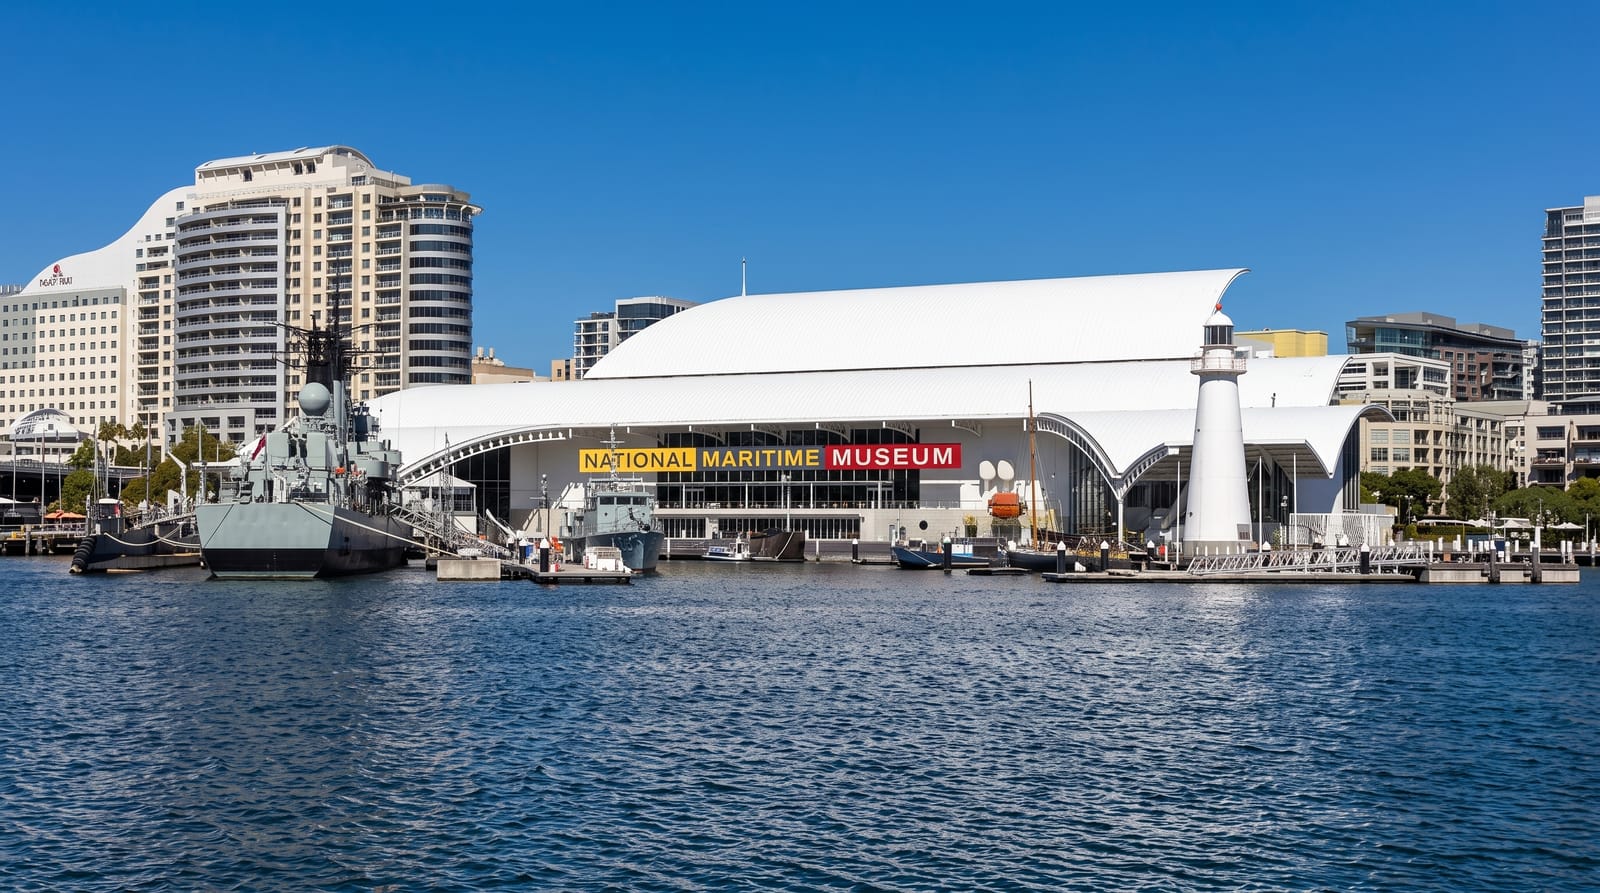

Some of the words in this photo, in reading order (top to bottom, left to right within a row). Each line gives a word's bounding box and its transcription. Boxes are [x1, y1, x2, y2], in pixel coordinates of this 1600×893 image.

[584, 452, 693, 468] NATIONAL
[702, 449, 820, 467] MARITIME
[832, 448, 953, 466] MUSEUM
